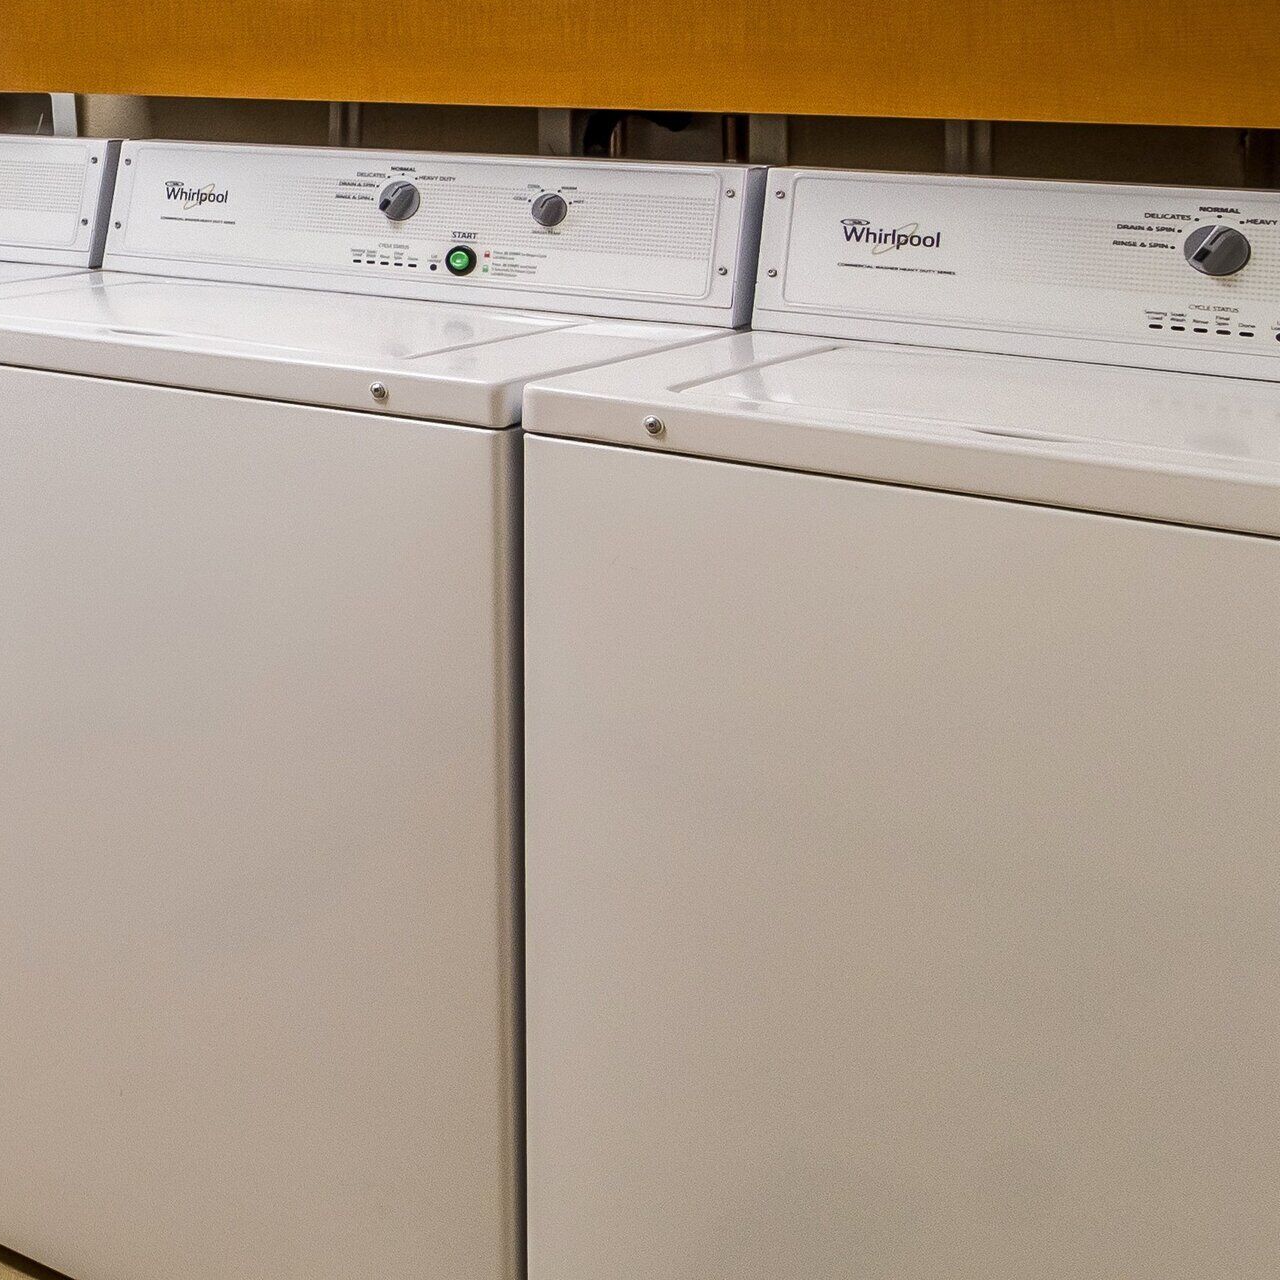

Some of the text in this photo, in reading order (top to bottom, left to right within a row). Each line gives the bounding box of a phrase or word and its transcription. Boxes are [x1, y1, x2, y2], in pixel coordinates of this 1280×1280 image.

[166, 187, 228, 205] Whirlpool
[1199, 206, 1241, 214] NORMAL
[1144, 212, 1192, 221] DELICATES
[1246, 218, 1278, 226] HEAVY
[1116, 223, 1145, 231] DRAIN
[452, 231, 478, 240] START
[843, 225, 941, 250] Whirlpool
[1112, 239, 1138, 247] RINSE
